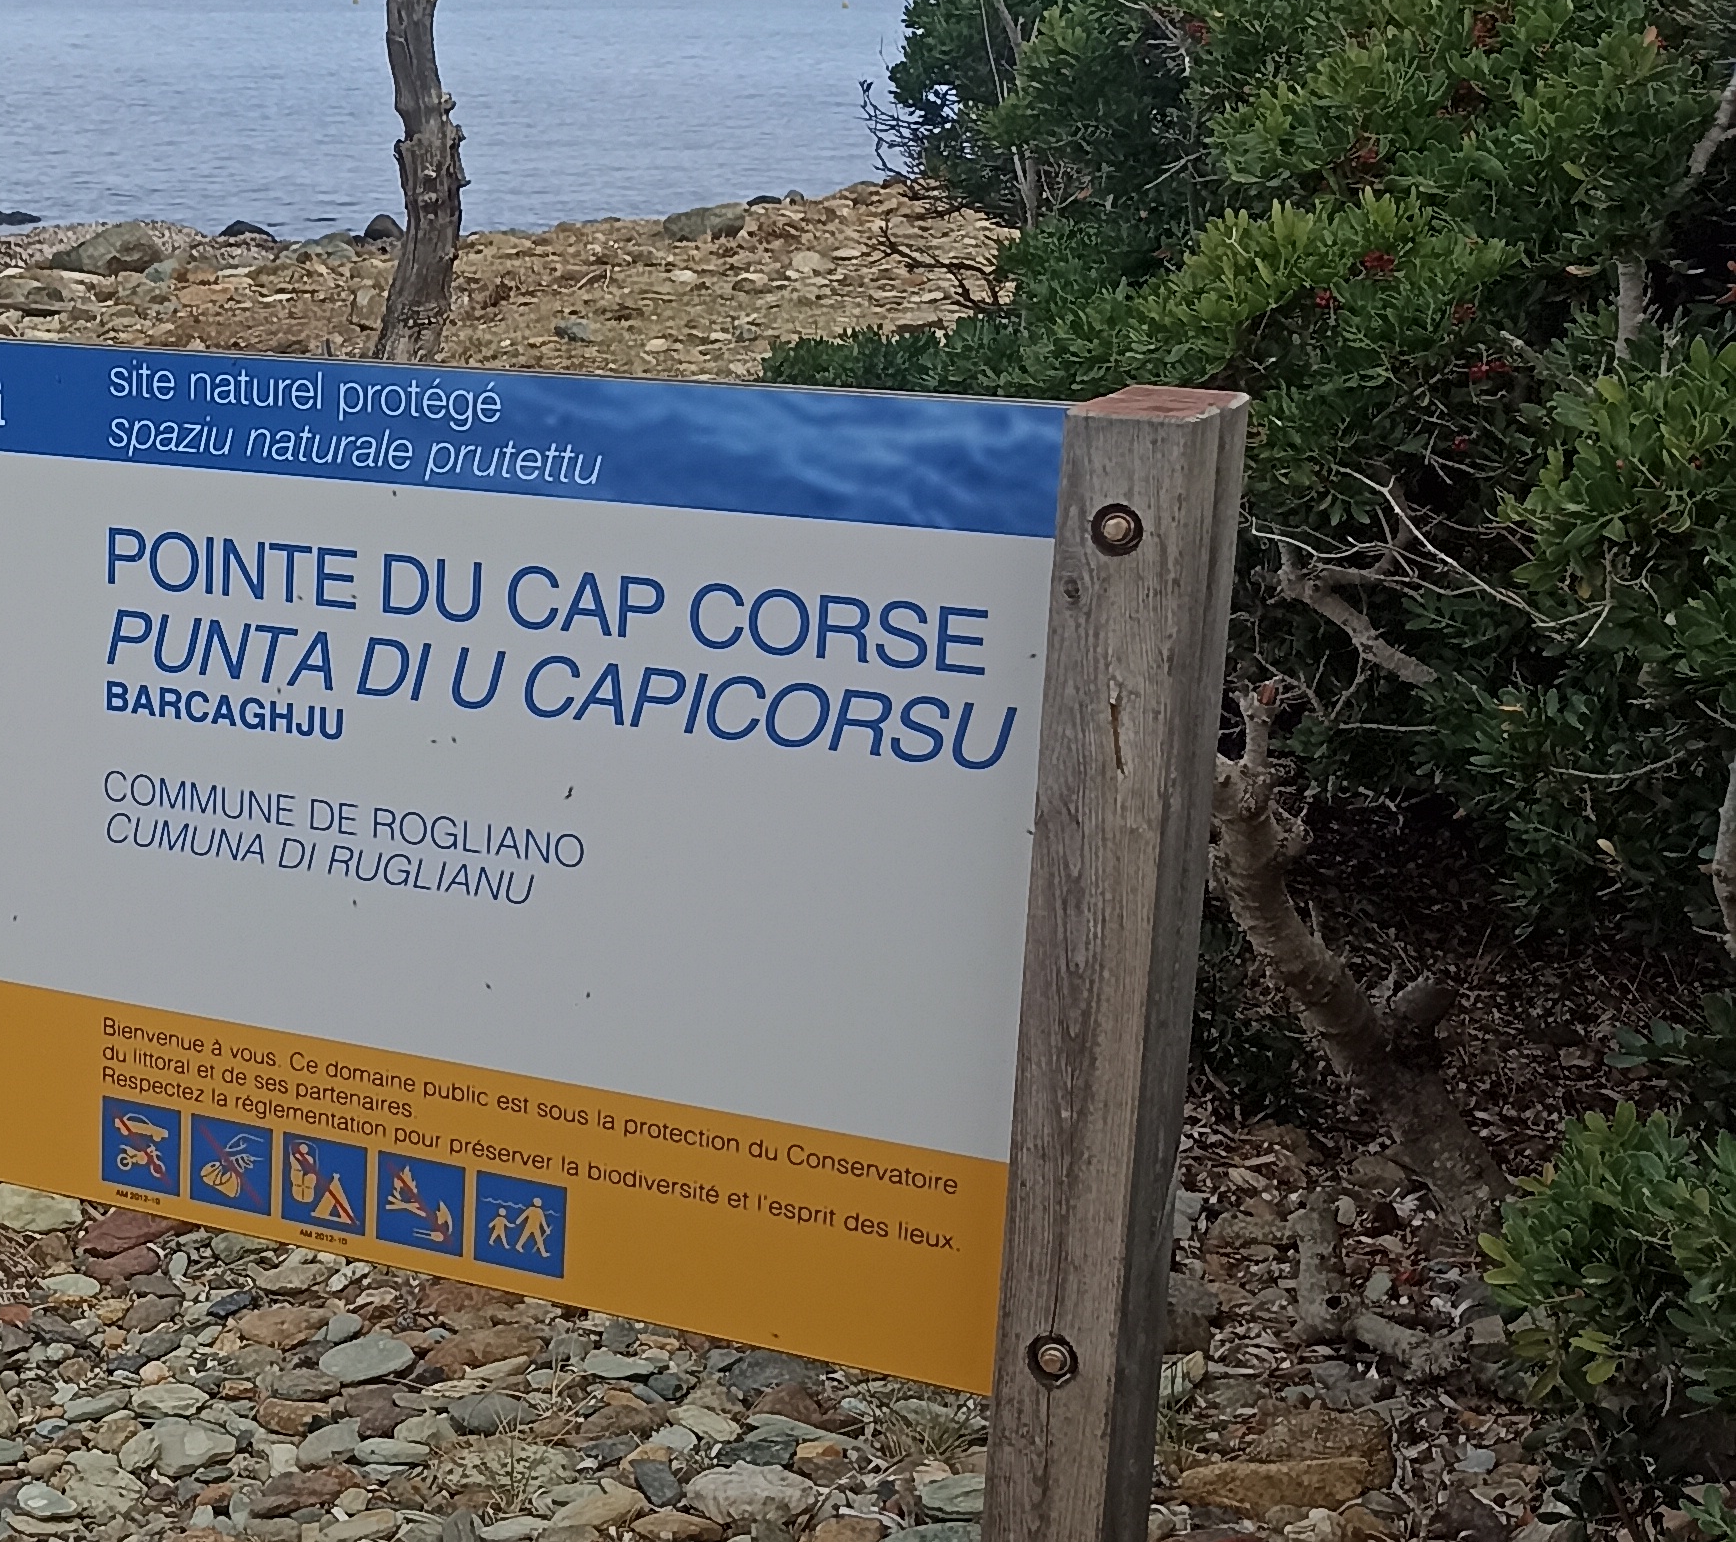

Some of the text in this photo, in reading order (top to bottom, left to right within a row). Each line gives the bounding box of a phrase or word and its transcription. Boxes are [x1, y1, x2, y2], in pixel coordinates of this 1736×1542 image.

[109, 359, 502, 431] site naturel protégé
[108, 415, 603, 485] spaziu naturale prutettu
[106, 526, 989, 676] POINTE DU CAP CORSE
[106, 680, 344, 740] BARCAGHJU
[107, 609, 1018, 771] PUNTA DI U CAPICORSU
[104, 770, 585, 868] COMMUNE DE ROGLIANO
[106, 812, 535, 905] CUMUNA DI RUGLIANU
[102, 1045, 418, 1120] du littoral et de ses partenaires.
[103, 1016, 958, 1195] Bienvenue à vous. Ce domaine public est sous la protection du Conservatoire
[102, 1066, 962, 1253] Respectez la réglementation pour préserver la biodiversité et l'esprit des lieux.
